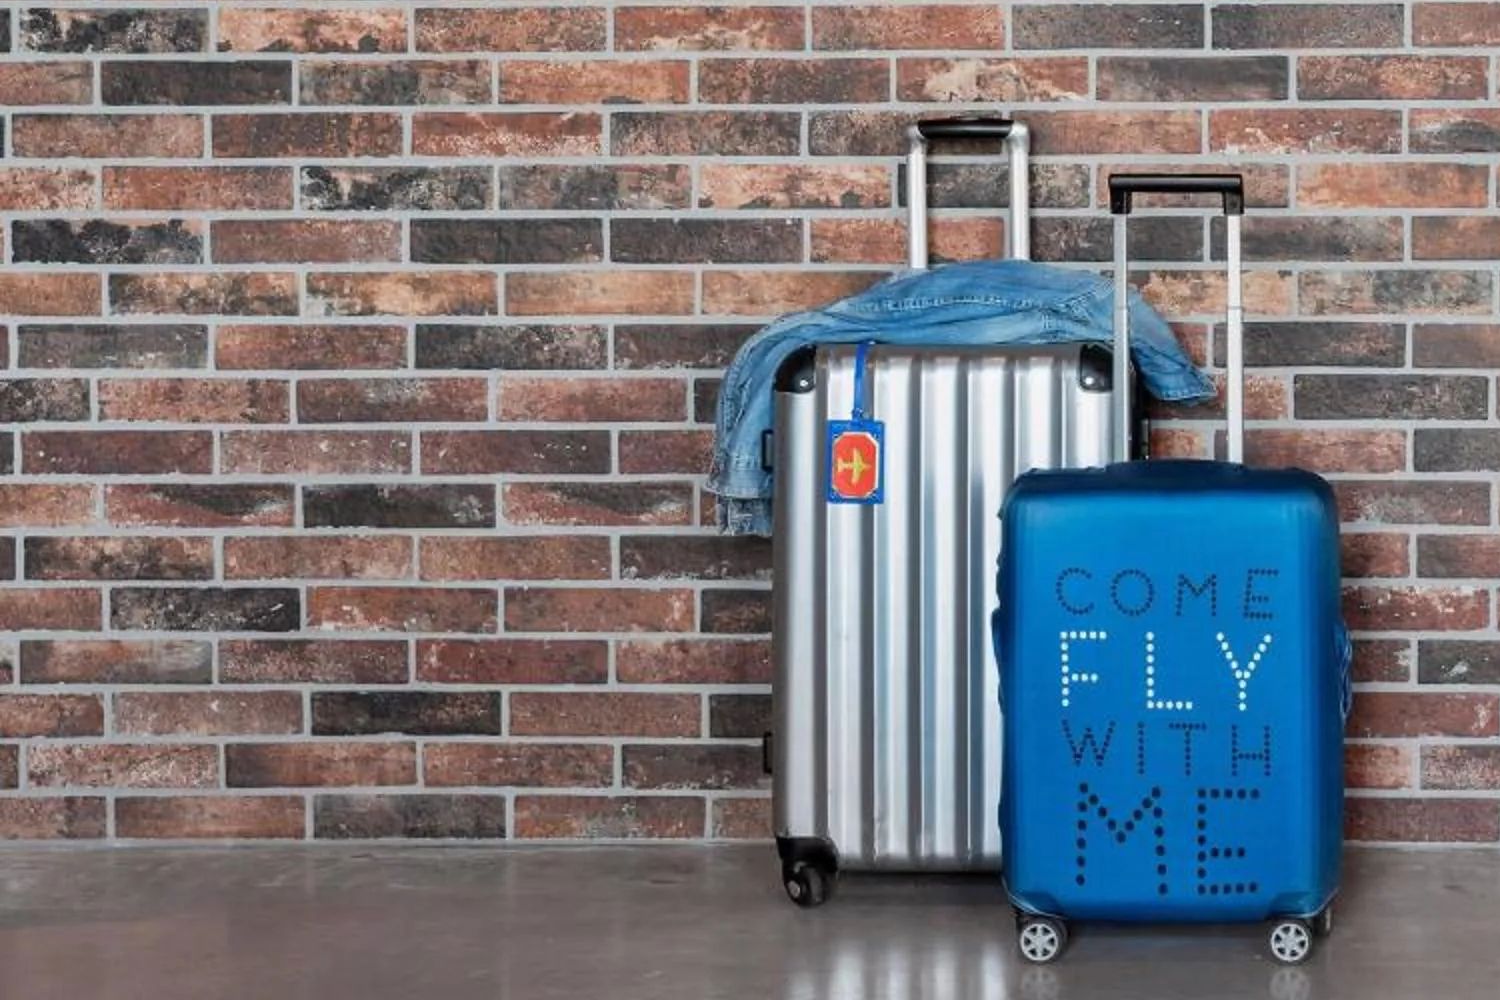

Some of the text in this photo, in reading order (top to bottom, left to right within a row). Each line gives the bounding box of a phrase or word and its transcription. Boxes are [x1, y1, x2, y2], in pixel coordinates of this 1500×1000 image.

[1055, 567, 1279, 620] COME
[1060, 631, 1272, 711] FLY
[1061, 719, 1272, 777] WITH
[1077, 783, 1261, 894] ME
